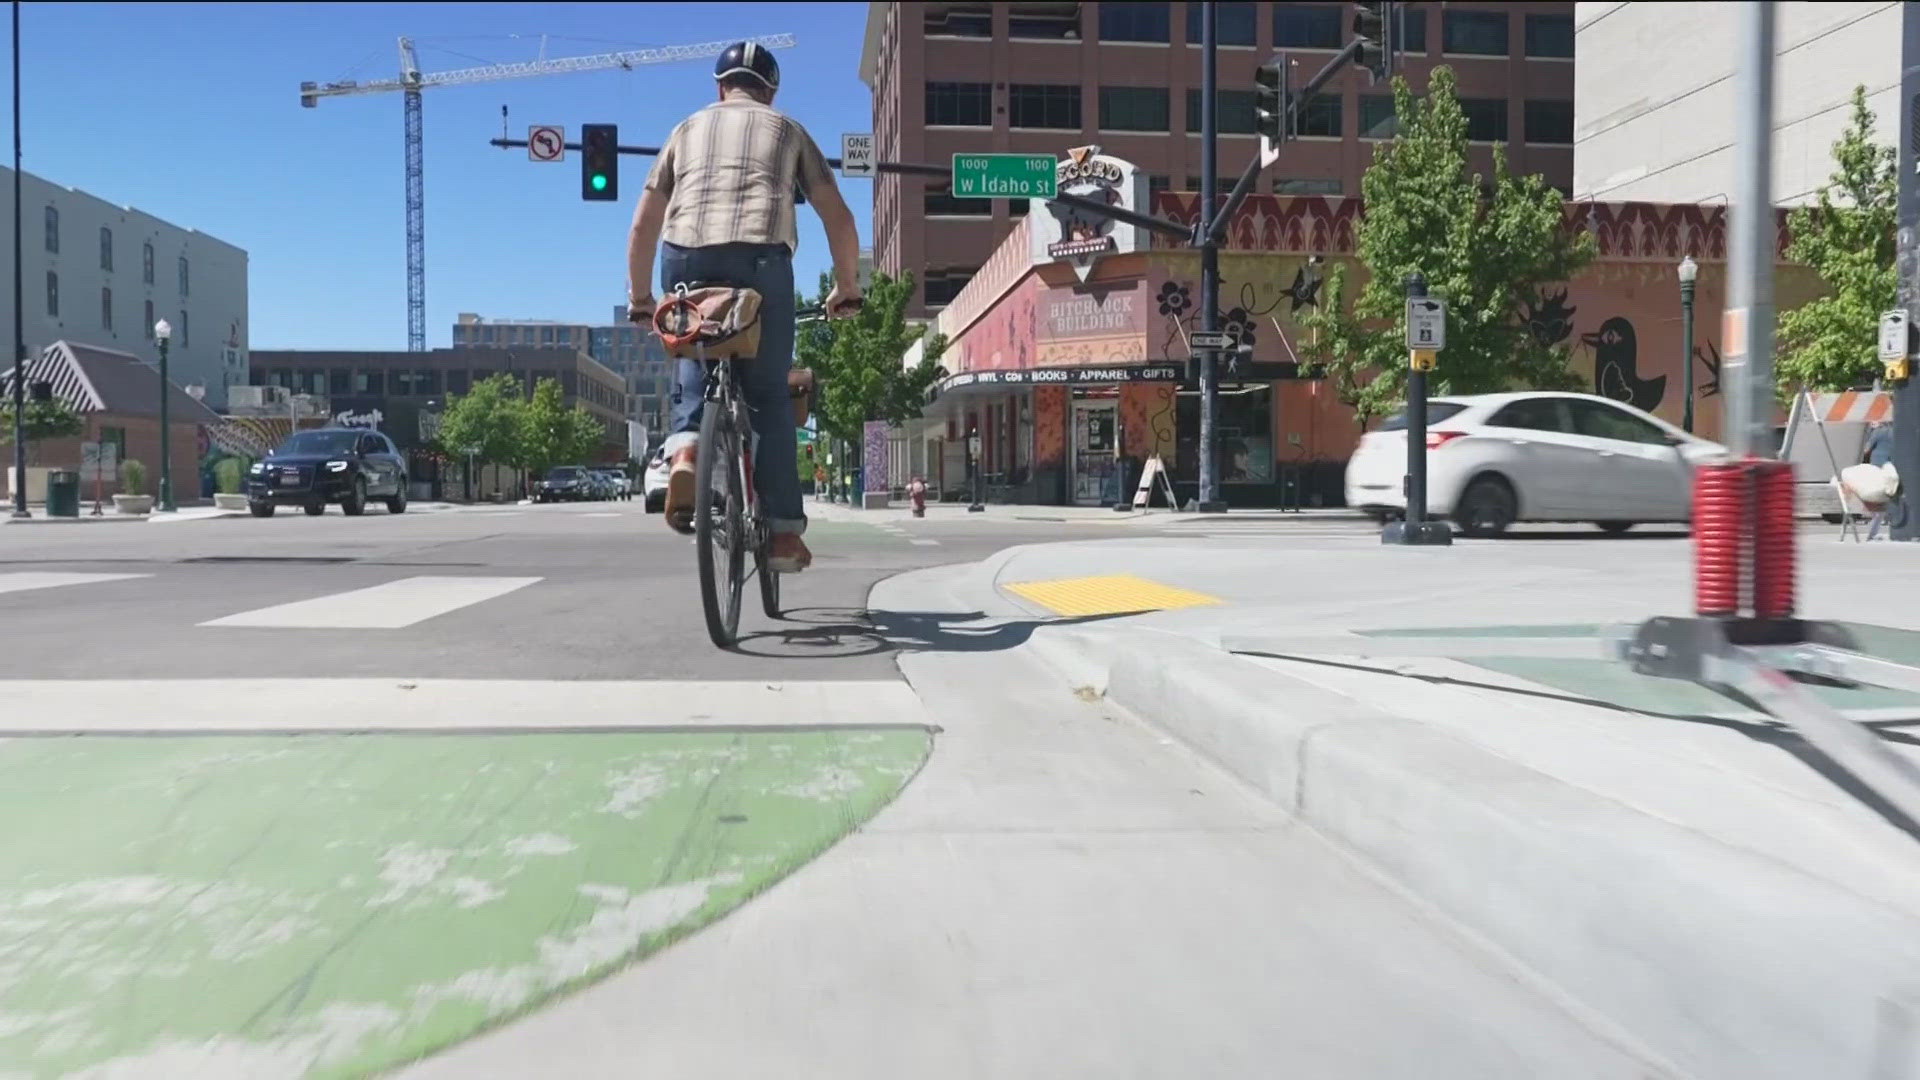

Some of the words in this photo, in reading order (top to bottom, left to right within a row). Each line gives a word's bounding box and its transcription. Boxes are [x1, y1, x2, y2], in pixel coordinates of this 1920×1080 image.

[847, 137, 870, 148] ONE
[848, 149, 870, 160] WAY
[961, 159, 988, 170] 1000
[1025, 160, 1049, 171] 1100
[961, 178, 974, 192] W
[981, 173, 1029, 193] Idaho
[1036, 180, 1049, 193] St
[1057, 313, 1124, 332] BUILDING
[1032, 370, 1068, 381] BOOKS
[1079, 369, 1131, 380] APPAREL
[1143, 368, 1175, 379] GIFTS
